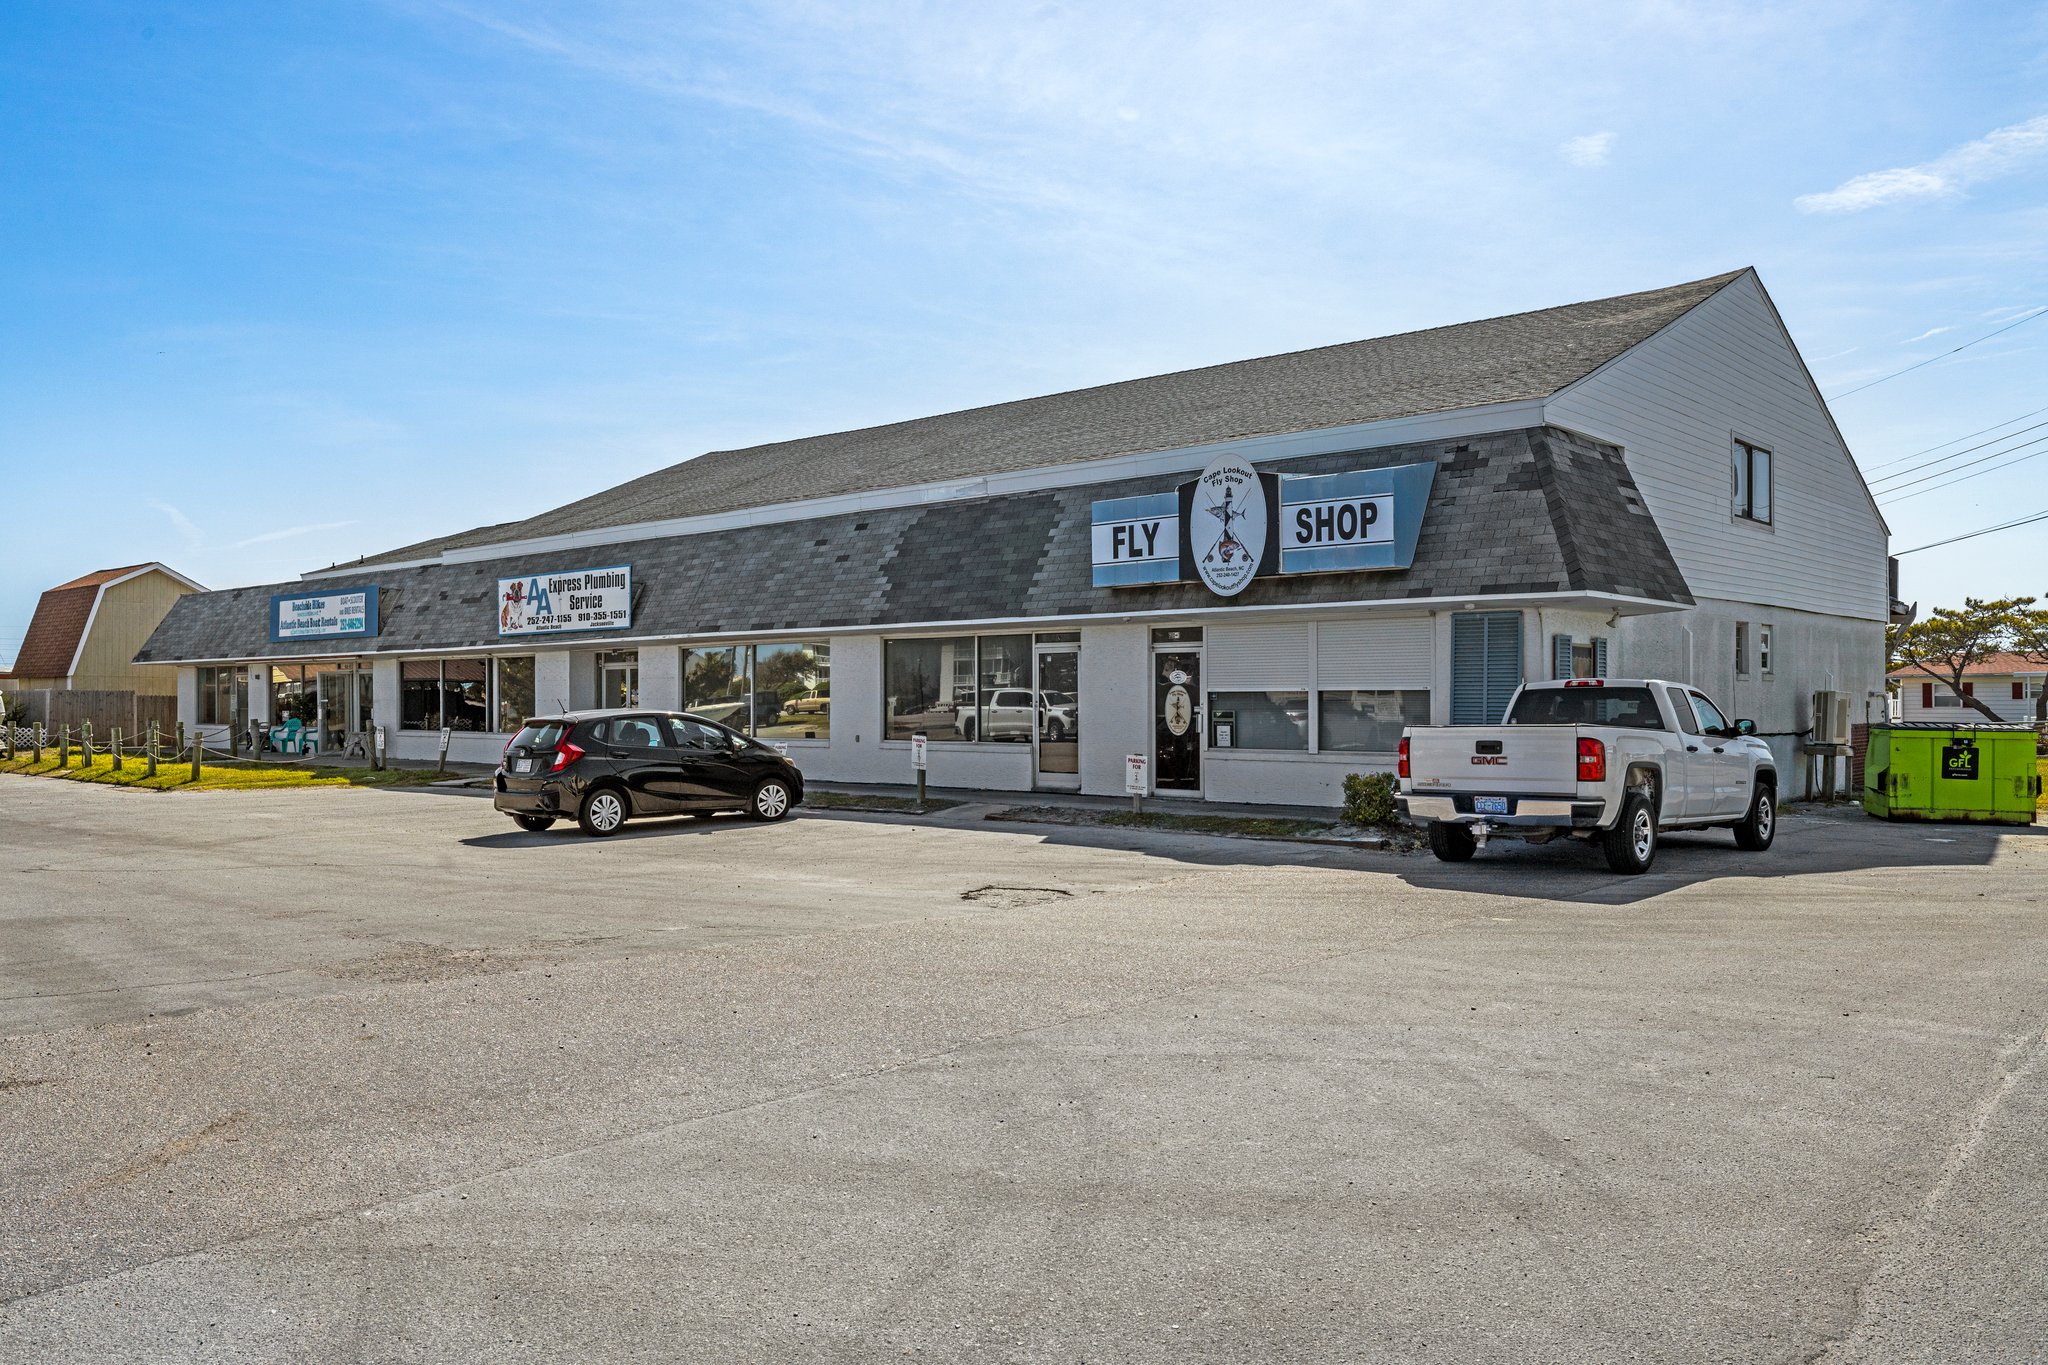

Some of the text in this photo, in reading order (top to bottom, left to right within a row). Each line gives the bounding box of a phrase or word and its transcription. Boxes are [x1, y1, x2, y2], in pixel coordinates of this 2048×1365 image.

[1203, 467, 1252, 483] Cape Lookout
[1211, 475, 1243, 487] Fly Shop
[1296, 502, 1378, 544] SHOP
[1112, 522, 1160, 560] FLY
[548, 572, 626, 595] Express Plumbing
[569, 591, 603, 610] Service
[527, 614, 572, 625] 252-247-1155
[577, 610, 627, 622] 910-355-1551
[1471, 756, 1508, 765] GMC
[1949, 754, 1972, 768] GFL
